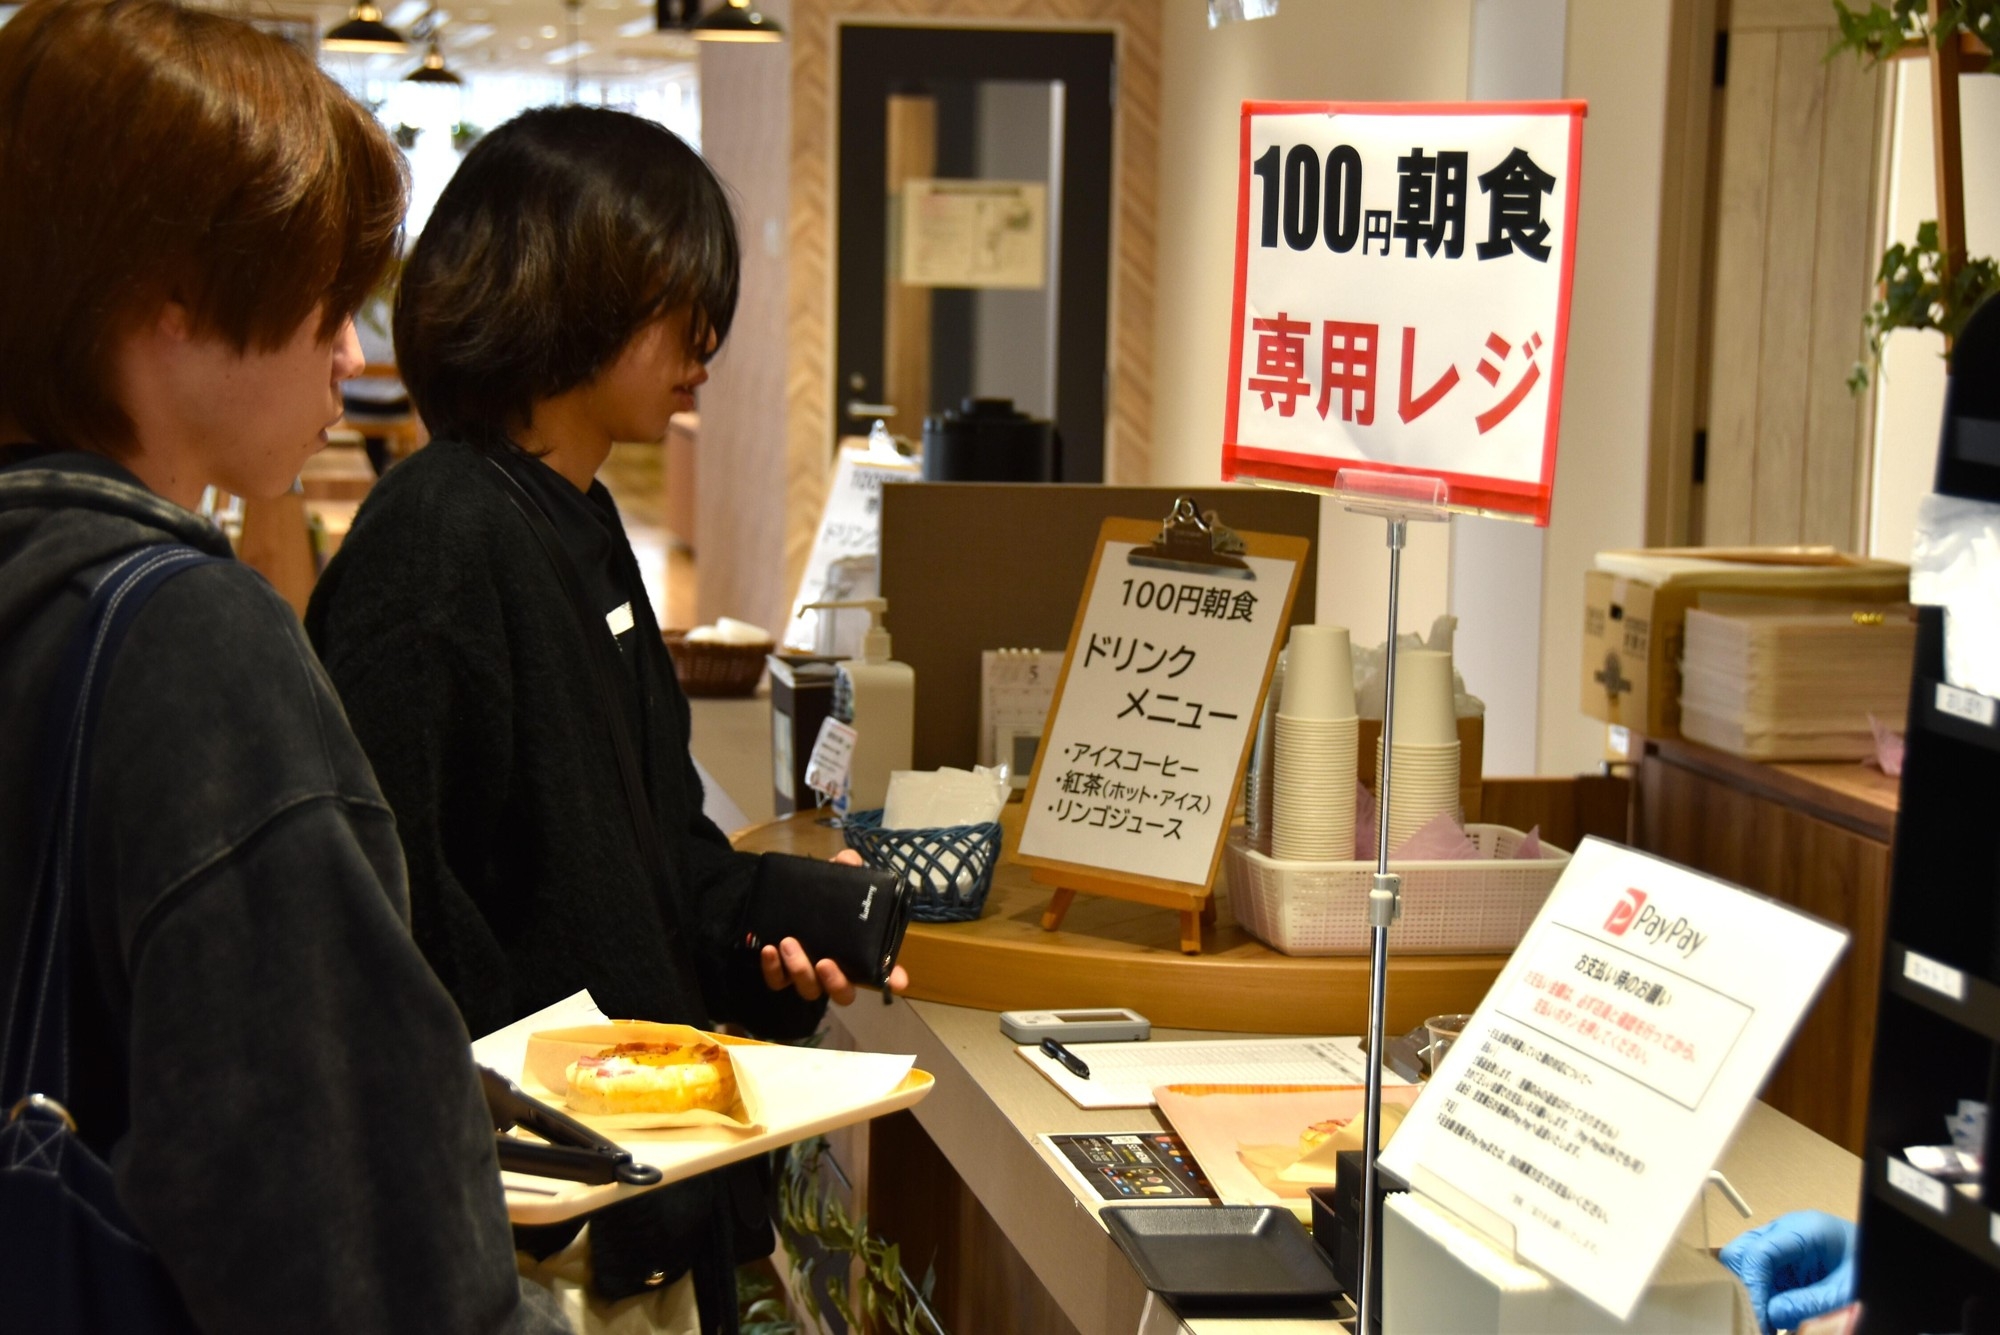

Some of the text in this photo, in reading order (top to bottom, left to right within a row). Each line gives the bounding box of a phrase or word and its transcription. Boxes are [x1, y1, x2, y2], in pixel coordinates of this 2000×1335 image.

[1254, 144, 1556, 263] 100円朝食
[1248, 312, 1543, 435] 専用レジ
[1122, 578, 1258, 623] 100円朝食
[1083, 633, 1196, 679] ドリンク
[1117, 688, 1237, 729] メニュー
[1633, 903, 1708, 958] PayPay
